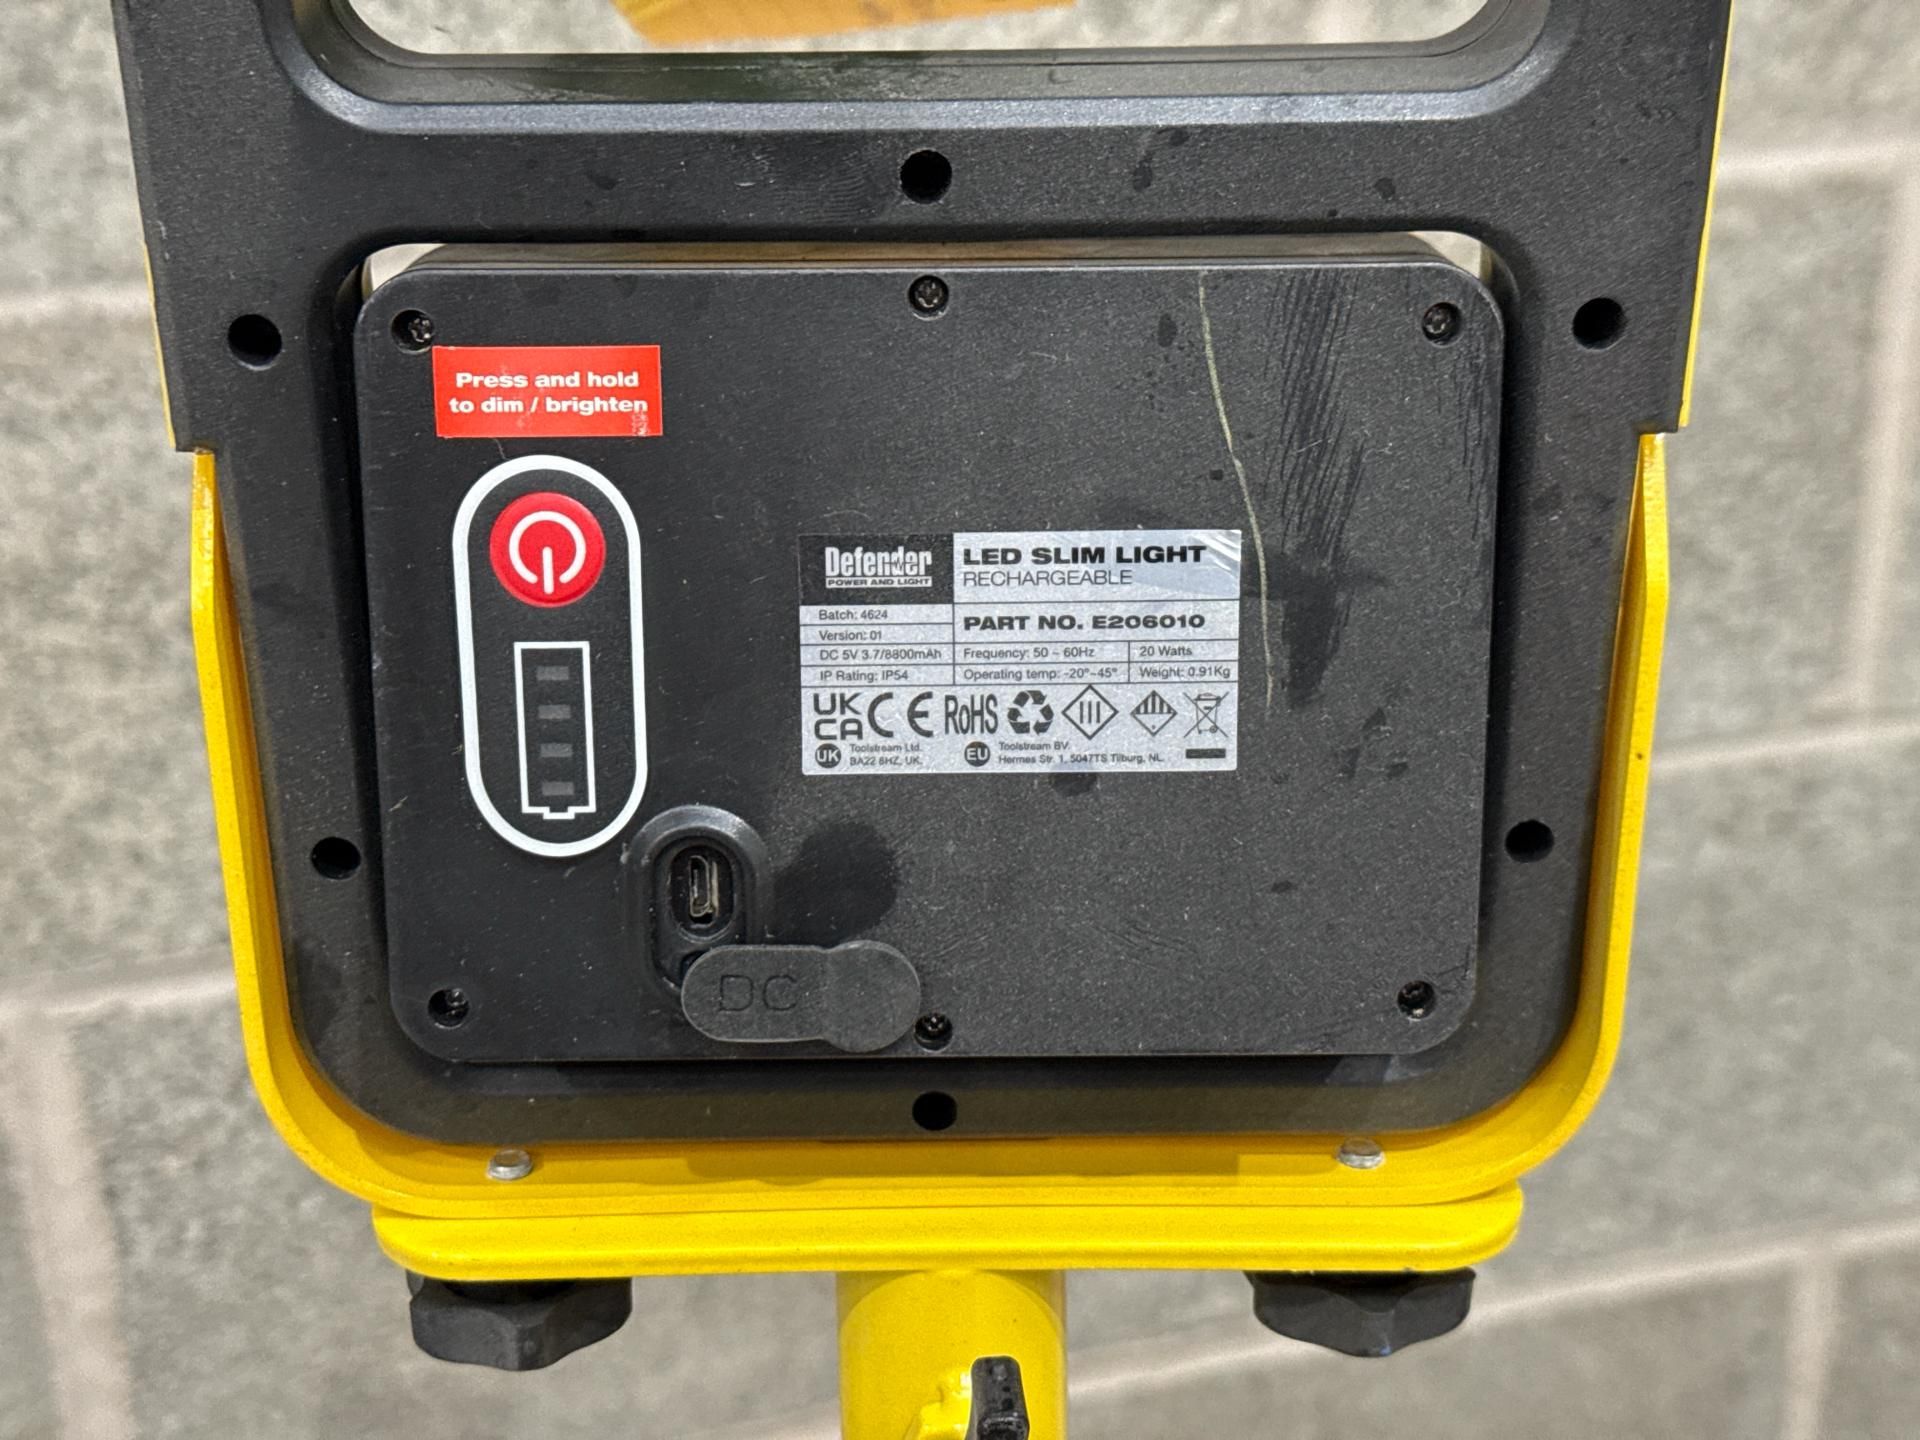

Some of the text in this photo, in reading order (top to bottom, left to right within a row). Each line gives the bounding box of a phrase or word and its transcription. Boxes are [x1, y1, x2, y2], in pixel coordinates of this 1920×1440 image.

[455, 371, 640, 388] Press and hold
[449, 397, 648, 416] to dim / brighten
[824, 546, 933, 577] Defender
[963, 546, 1206, 565] LED SLIM LIGHT
[870, 578, 895, 586] AND
[897, 577, 930, 585] LIGHT
[963, 570, 1133, 587] RECHARGEABLE
[818, 610, 888, 620] Batch: 4624
[963, 614, 1206, 630] PART NO. E206010
[818, 630, 883, 641] Version: 01
[819, 650, 838, 661] DC
[842, 650, 858, 660] 5V
[963, 647, 1030, 660] Frequency:
[1033, 647, 1049, 658] 50
[1063, 646, 1096, 658] 60Hz
[1139, 645, 1193, 657] 20 Watts
[820, 670, 909, 683] IP Rating: IP54
[963, 668, 1023, 682] Operating
[1139, 665, 1231, 678] Weight: 0.91Kg
[813, 692, 863, 715] UK
[944, 693, 999, 735] RoHS
[849, 743, 903, 753] Toolstream
[999, 741, 1051, 751] Toolstream
[816, 749, 841, 763] UK
[966, 748, 989, 760] EU
[999, 755, 1037, 764] Hermes
[849, 756, 876, 766] BA22
[719, 974, 798, 1012] DC
